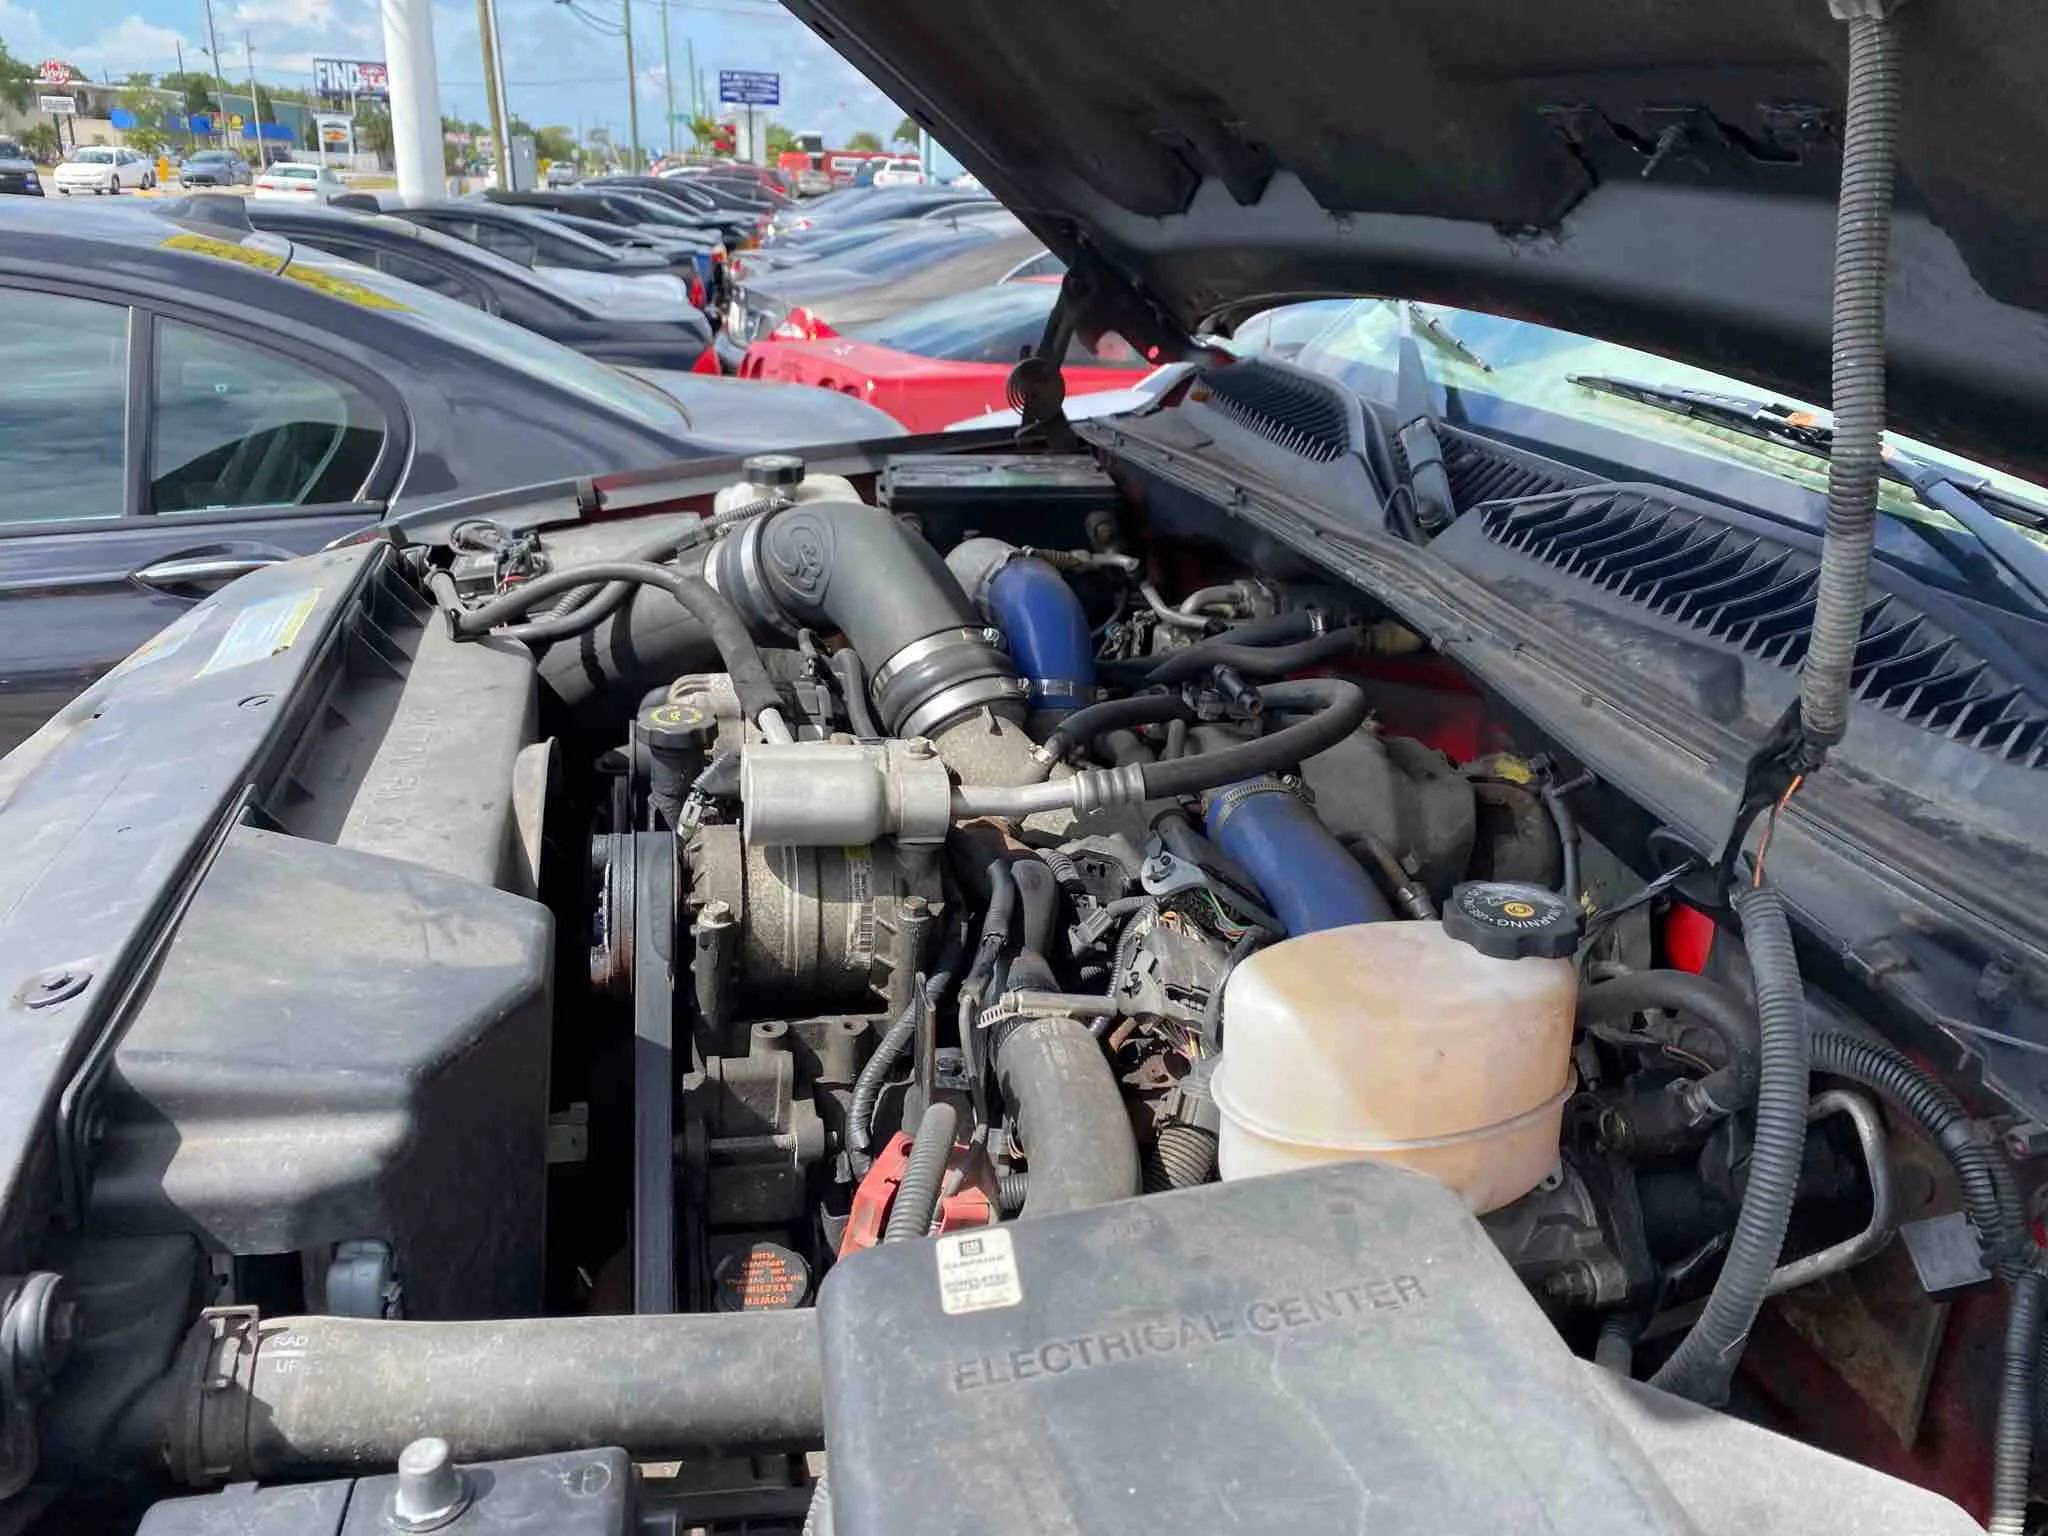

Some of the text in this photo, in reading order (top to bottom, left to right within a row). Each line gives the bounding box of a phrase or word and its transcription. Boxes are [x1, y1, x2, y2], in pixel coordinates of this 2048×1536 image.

[315, 61, 361, 92] FIND
[952, 1273, 1428, 1391] ELECTRICAL CENTER
